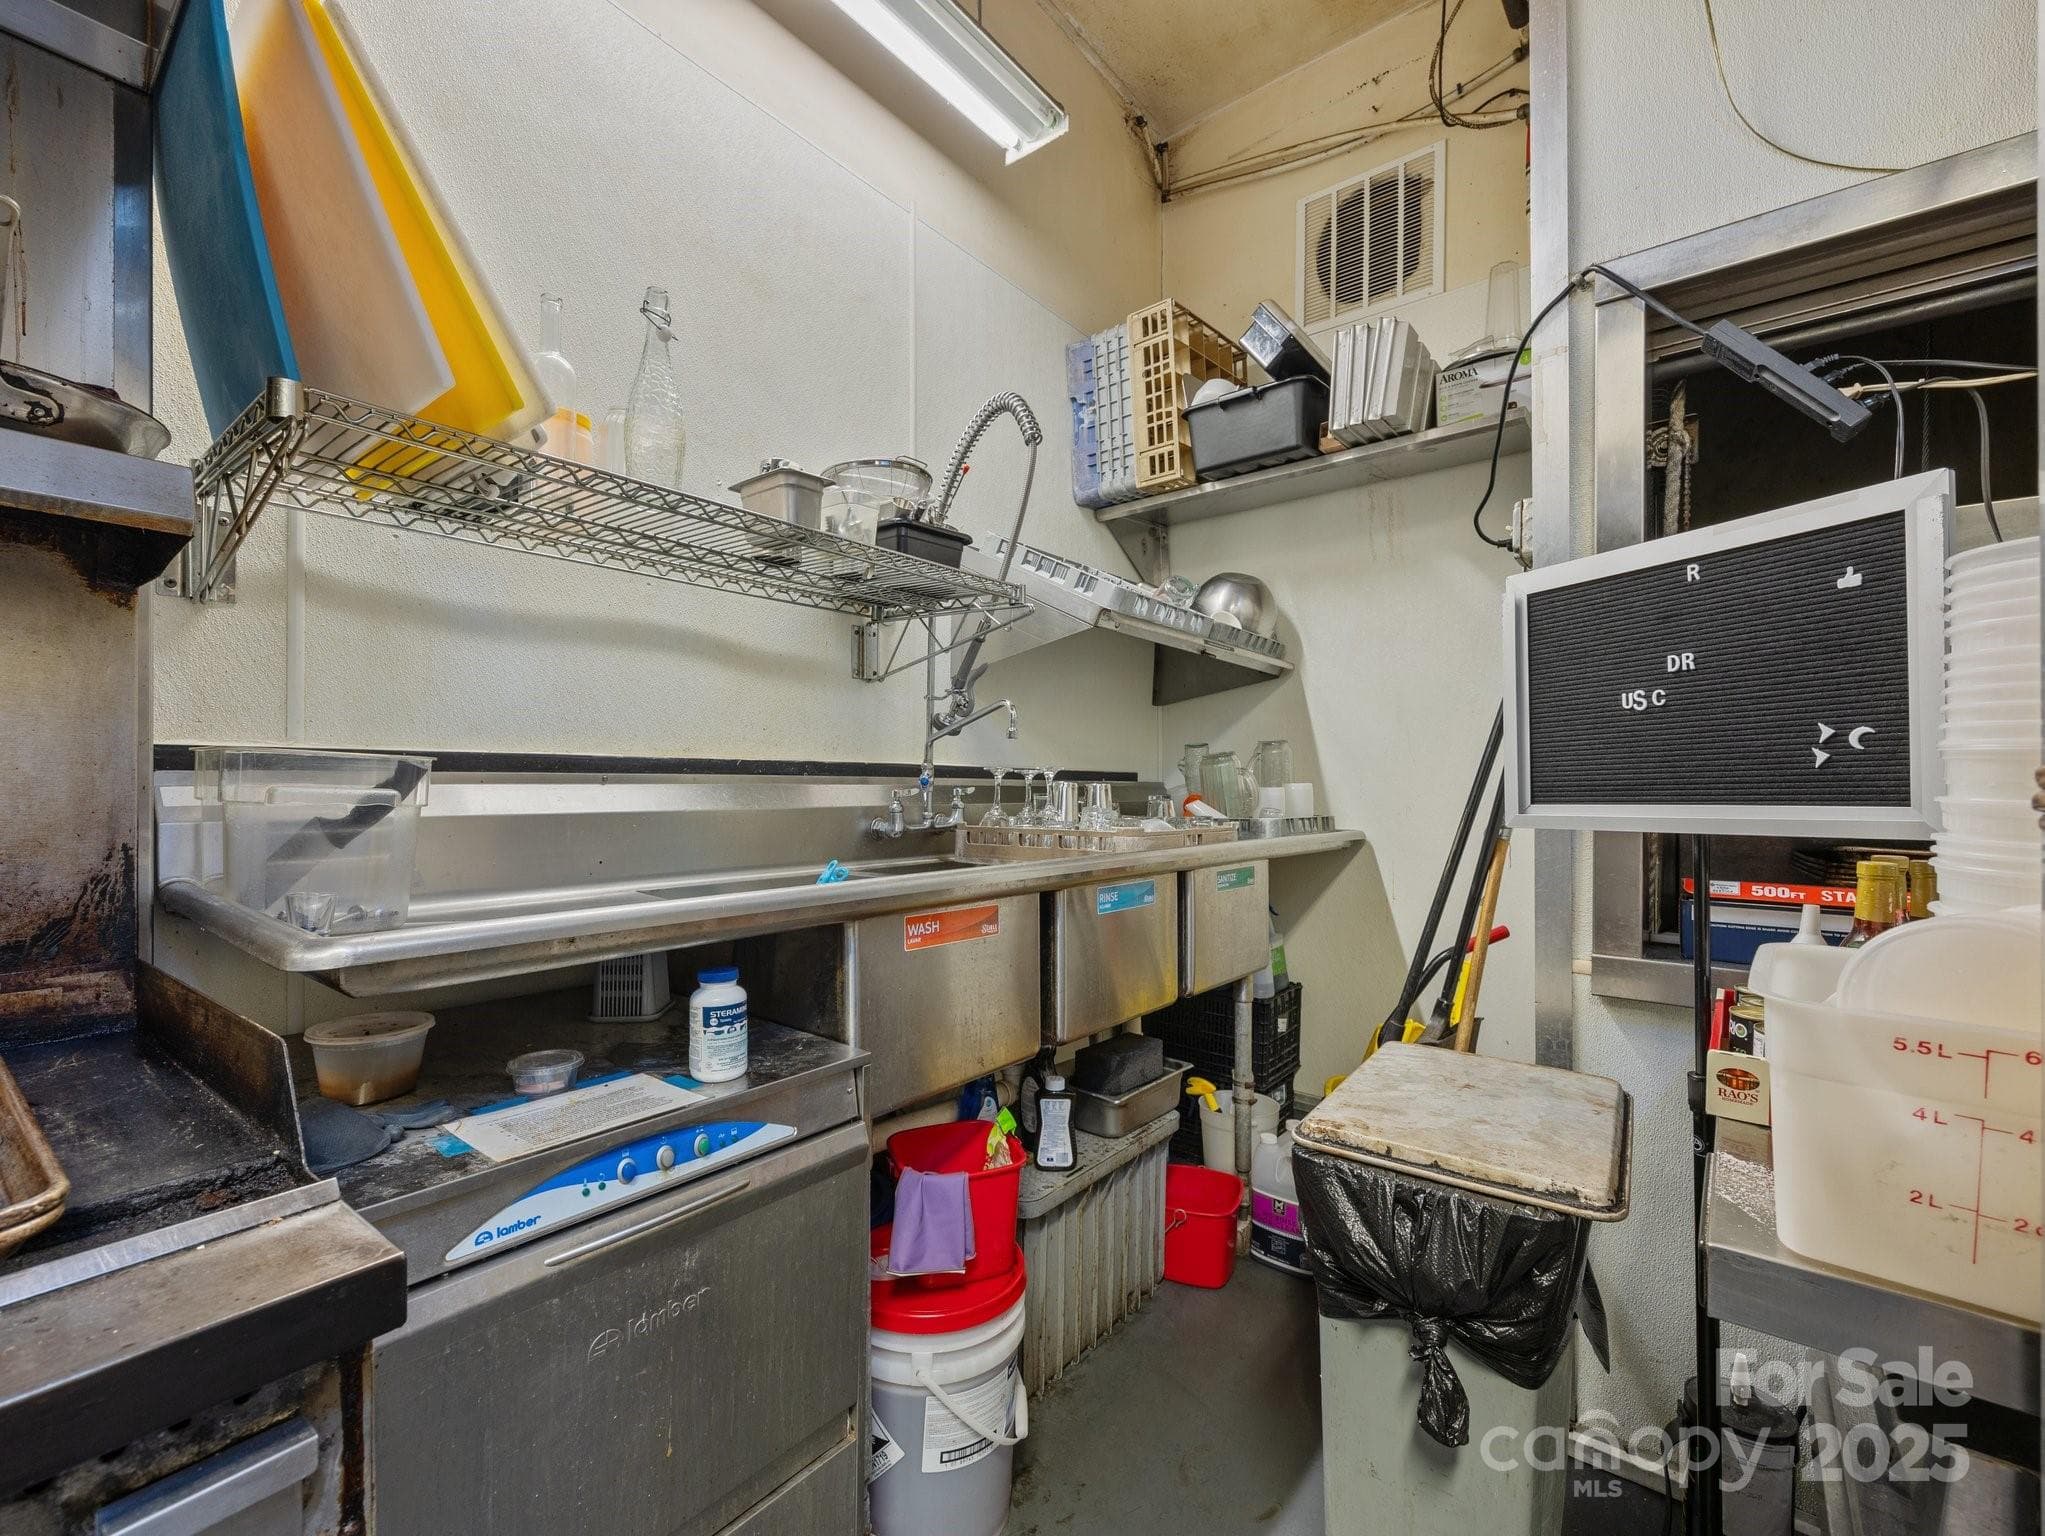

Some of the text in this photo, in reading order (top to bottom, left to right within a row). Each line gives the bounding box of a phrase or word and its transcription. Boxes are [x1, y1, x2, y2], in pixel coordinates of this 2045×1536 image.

[1440, 367, 1478, 384] AROMA
[1686, 564, 1701, 582] R
[1667, 652, 1696, 672] DR
[1100, 891, 1119, 903] RINSE
[907, 920, 940, 937] WASH
[2025, 1051, 2042, 1065] 6
[1718, 1088, 1759, 1104] RAO'S
[2019, 1130, 2035, 1143] 4
[496, 1215, 541, 1238] lamber
